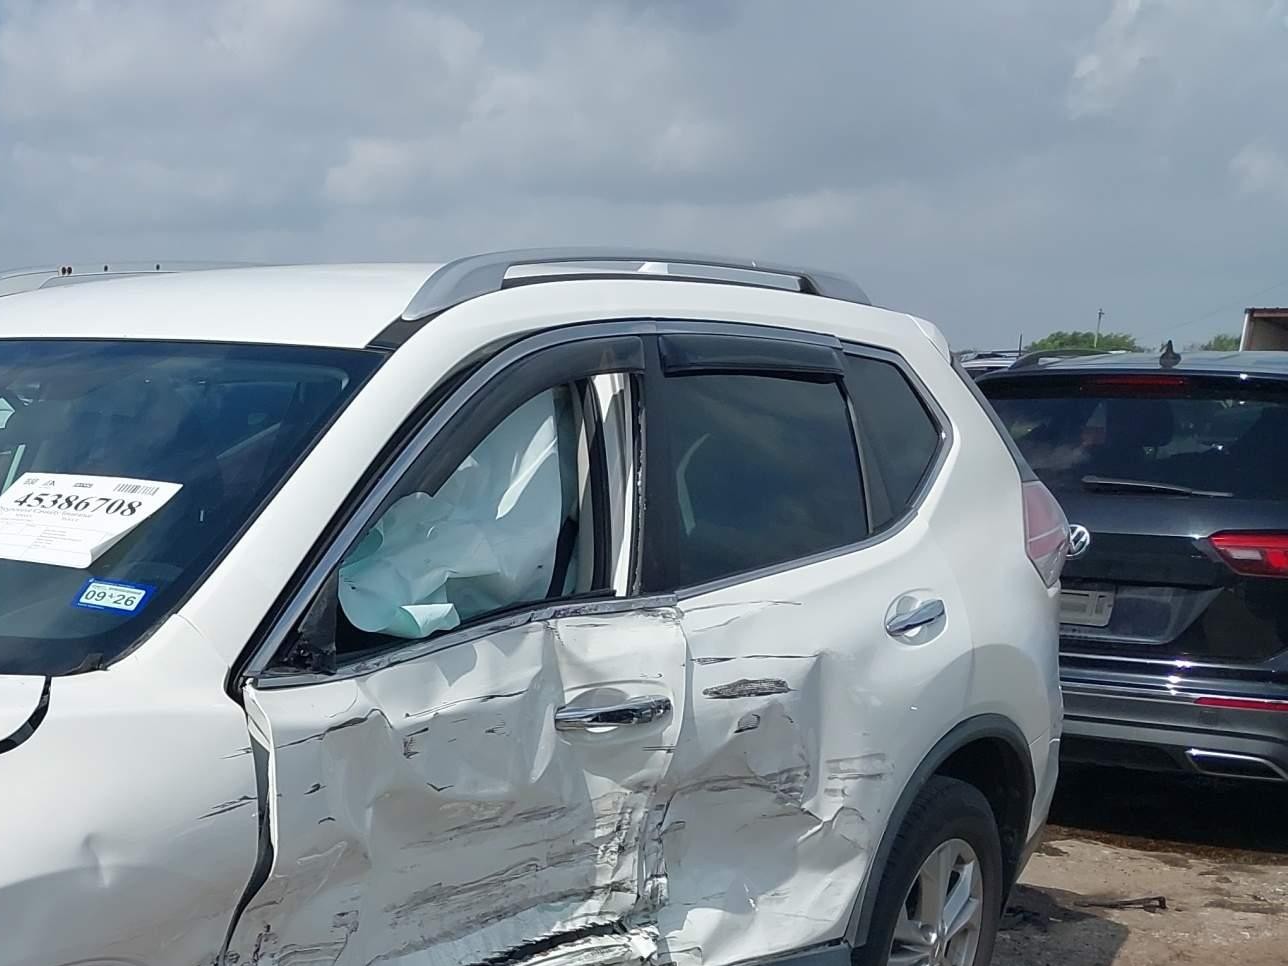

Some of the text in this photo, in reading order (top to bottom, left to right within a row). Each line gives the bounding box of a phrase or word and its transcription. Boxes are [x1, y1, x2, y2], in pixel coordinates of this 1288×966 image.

[14, 492, 143, 517] 45386708
[84, 589, 107, 602] 09
[112, 594, 137, 607] 26
